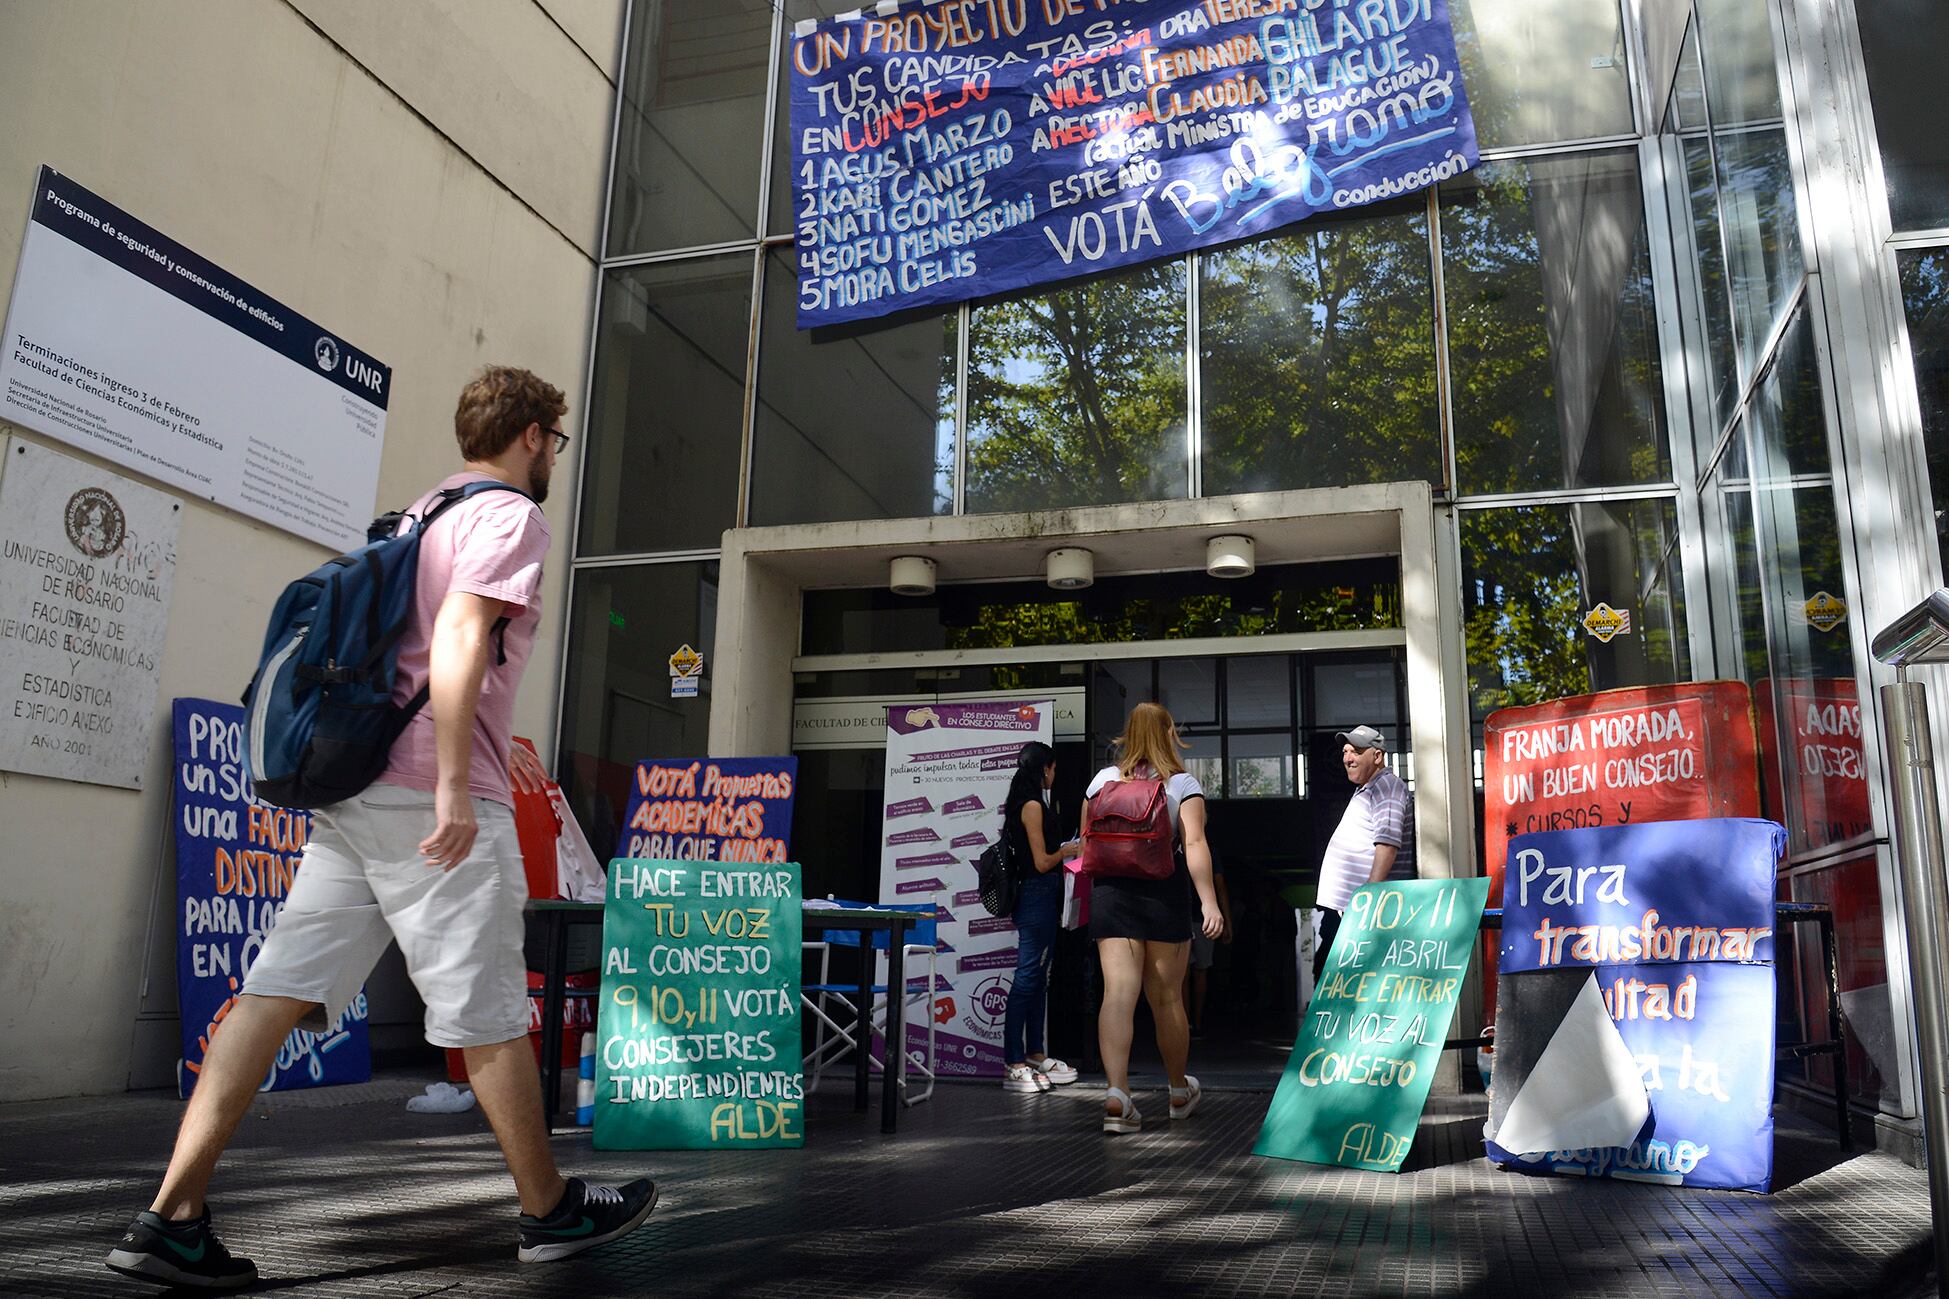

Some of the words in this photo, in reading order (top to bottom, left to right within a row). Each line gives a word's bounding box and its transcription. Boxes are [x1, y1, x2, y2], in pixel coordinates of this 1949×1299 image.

[794, 28, 850, 77] UN
[807, 65, 878, 118] TUS
[1028, 93, 1050, 118] A
[1043, 67, 1104, 111] VICE
[1140, 33, 1268, 86] FERNANDA
[801, 127, 844, 155] EN
[842, 71, 991, 153] CONSEJO
[1031, 128, 1052, 153] A
[1048, 100, 1157, 150] RECTORA
[1274, 102, 1303, 124] de
[800, 159, 819, 190] 1
[820, 149, 900, 190] AGUS
[903, 108, 1013, 168] MARZO
[800, 192, 819, 220] 2
[889, 141, 1014, 205] CANTERO
[1048, 168, 1117, 209] ESTE
[1117, 155, 1163, 191] AÑO
[799, 221, 818, 248] 3
[888, 176, 993, 233] GOMEZ
[1043, 188, 1163, 265] VOTÁ
[46, 189, 101, 228] Programa
[101, 221, 116, 237] de
[116, 231, 168, 266] seguridad
[167, 259, 176, 272] y
[175, 265, 236, 305] conservación
[235, 298, 249, 311] de
[248, 305, 285, 332] edificios
[800, 252, 821, 279] 4
[820, 235, 893, 278] SOFU
[800, 279, 822, 312] 5
[821, 263, 896, 310] MORA
[17, 334, 99, 381] Terminaciones
[99, 372, 140, 399] ingreso
[140, 392, 148, 403] 3
[149, 395, 163, 410] de
[163, 402, 201, 427] Febrero
[345, 355, 383, 395] UNR
[9, 377, 49, 400] Universidad
[49, 394, 76, 411] Nacional
[84, 409, 107, 424] Rosario
[13, 350, 59, 379] Facultad
[60, 372, 74, 385] de
[75, 378, 116, 404] Ciencias
[117, 396, 171, 428] Económicas
[171, 422, 178, 433] y
[178, 424, 224, 452] Estadística
[50, 405, 96, 428] Infraestructura
[47, 412, 93, 437] Construcciones
[4, 539, 95, 582] UNIVERSIDAD
[99, 570, 163, 603] NACIONAL
[43, 574, 63, 596] DE
[65, 580, 125, 614] ROSARIO
[0, 618, 58, 649] IENCIAS
[107, 621, 126, 641] DE
[69, 657, 81, 677] Y
[22, 672, 113, 709] ESTADISTICA
[795, 718, 851, 729] FACULTAD
[853, 718, 869, 727] DE
[947, 717, 958, 726] EN
[958, 718, 994, 729] CONSEJO
[993, 719, 1032, 730] DIRECTIVO
[962, 711, 975, 720] LOS
[975, 712, 1017, 721] ESTUDIANTES
[1503, 722, 1586, 763] FRANJA
[1589, 707, 1695, 750] MORADA,
[637, 761, 701, 798] VOTÁ
[1503, 771, 1535, 806] UN
[1542, 761, 1598, 799] BUEN
[183, 804, 239, 842] una
[1526, 803, 1604, 834] CURSOS
[676, 836, 717, 862] QUE
[719, 837, 787, 864] NUNCA
[614, 863, 687, 899] HACE
[700, 870, 792, 899] ENTRAR
[1514, 847, 1631, 907] Para
[185, 896, 243, 937] PARA
[644, 902, 690, 940] TU
[701, 907, 771, 940] VOZ
[1429, 887, 1458, 929] 11
[1337, 939, 1372, 969] DE
[1381, 939, 1463, 970] ABRIL
[1533, 909, 1773, 967] transformar
[193, 942, 232, 978] EN
[605, 946, 638, 976] AL
[648, 944, 772, 977] CONSEJO
[723, 983, 796, 1018] VOTÁ
[984, 992, 1008, 1011] GPS
[1317, 971, 1377, 1003] HACE
[1376, 973, 1458, 1005] ENTRAR
[1313, 1011, 1340, 1040] TU
[1347, 1012, 1398, 1045] VOZ
[1399, 1011, 1438, 1049] AL
[603, 1030, 777, 1072] CONSEJERES
[1299, 1047, 1418, 1089] CONSEJO
[1677, 1044, 1731, 1103] la
[710, 1101, 801, 1142] ALDE
[1337, 1121, 1412, 1167] ALDE
